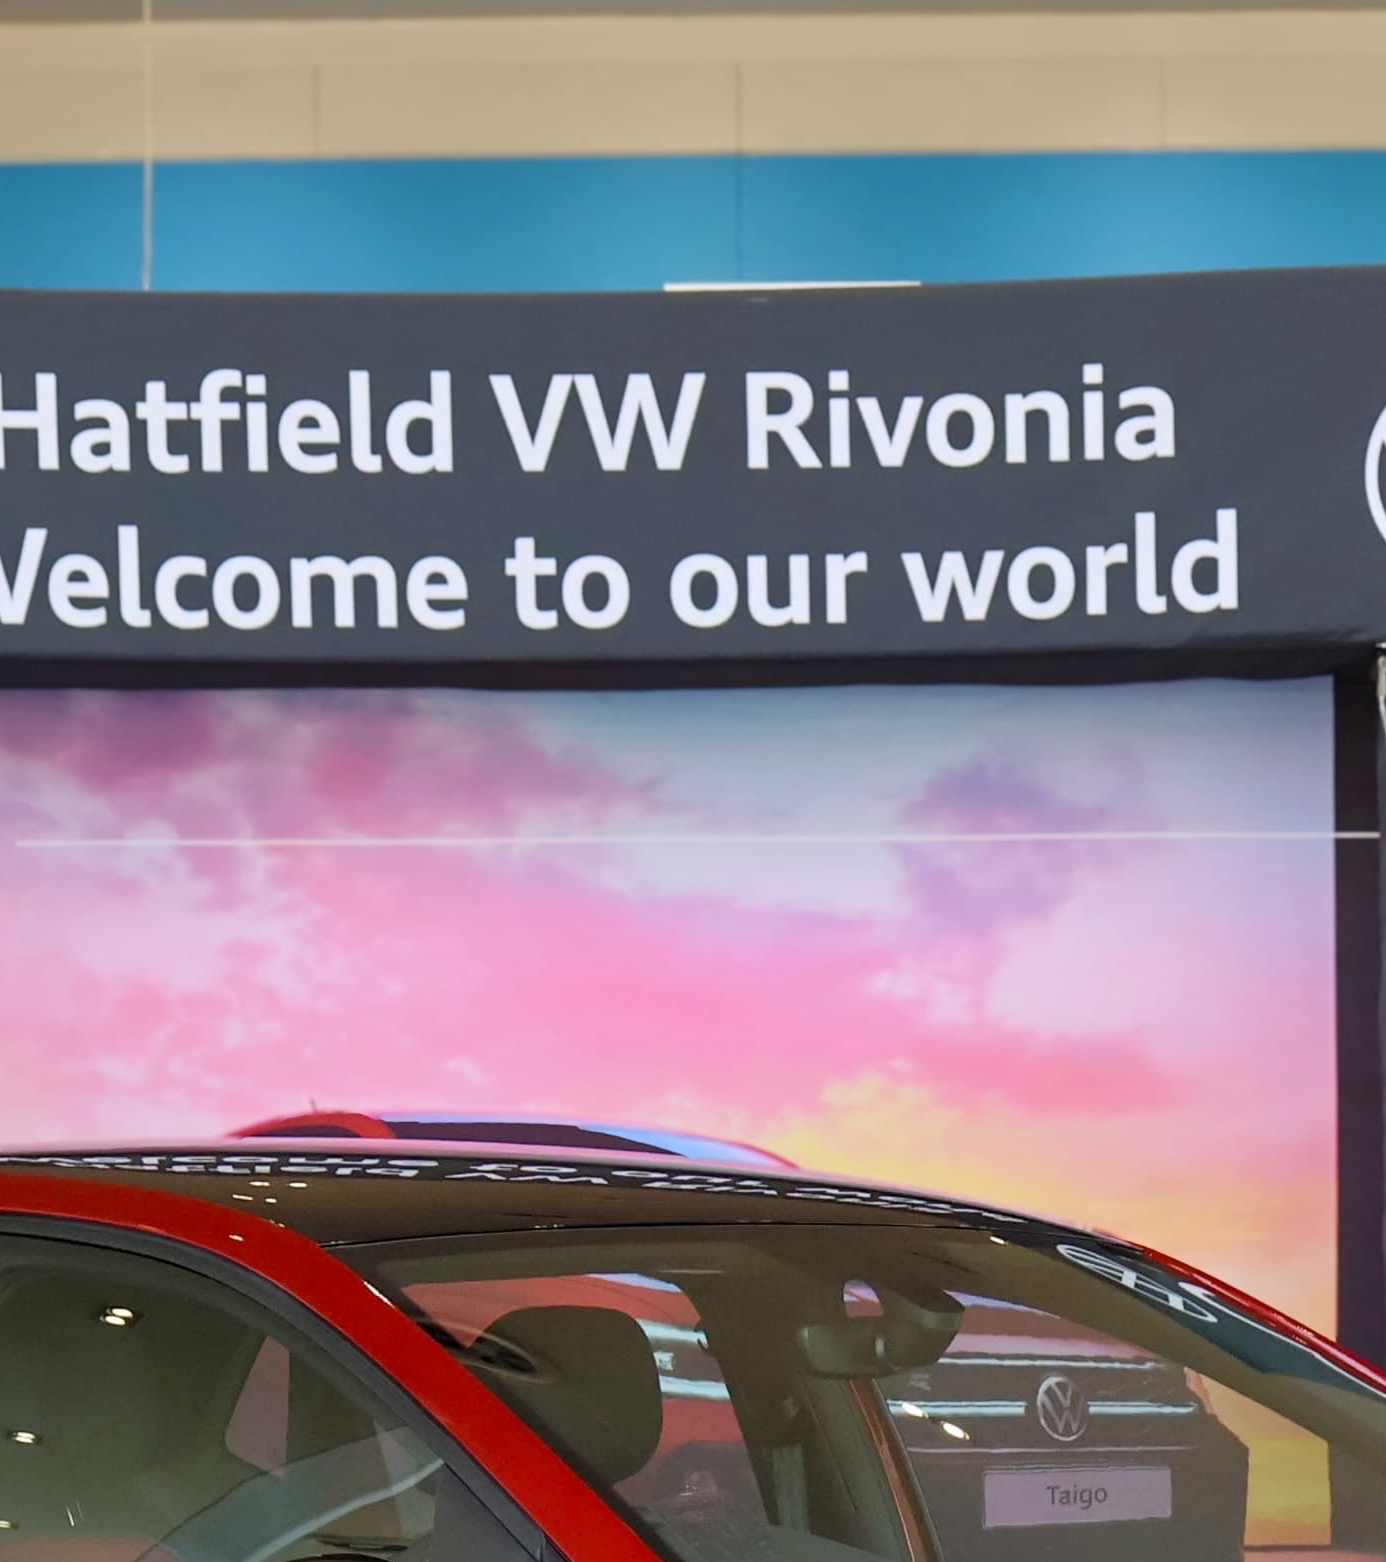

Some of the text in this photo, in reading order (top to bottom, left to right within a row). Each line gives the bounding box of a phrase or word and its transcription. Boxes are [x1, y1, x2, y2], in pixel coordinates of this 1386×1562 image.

[488, 371, 707, 473] VW
[744, 362, 1176, 470] Rivonia
[503, 535, 631, 631] to
[669, 550, 869, 629] our
[899, 507, 1240, 623] world
[1046, 1484, 1108, 1511] Taigo
